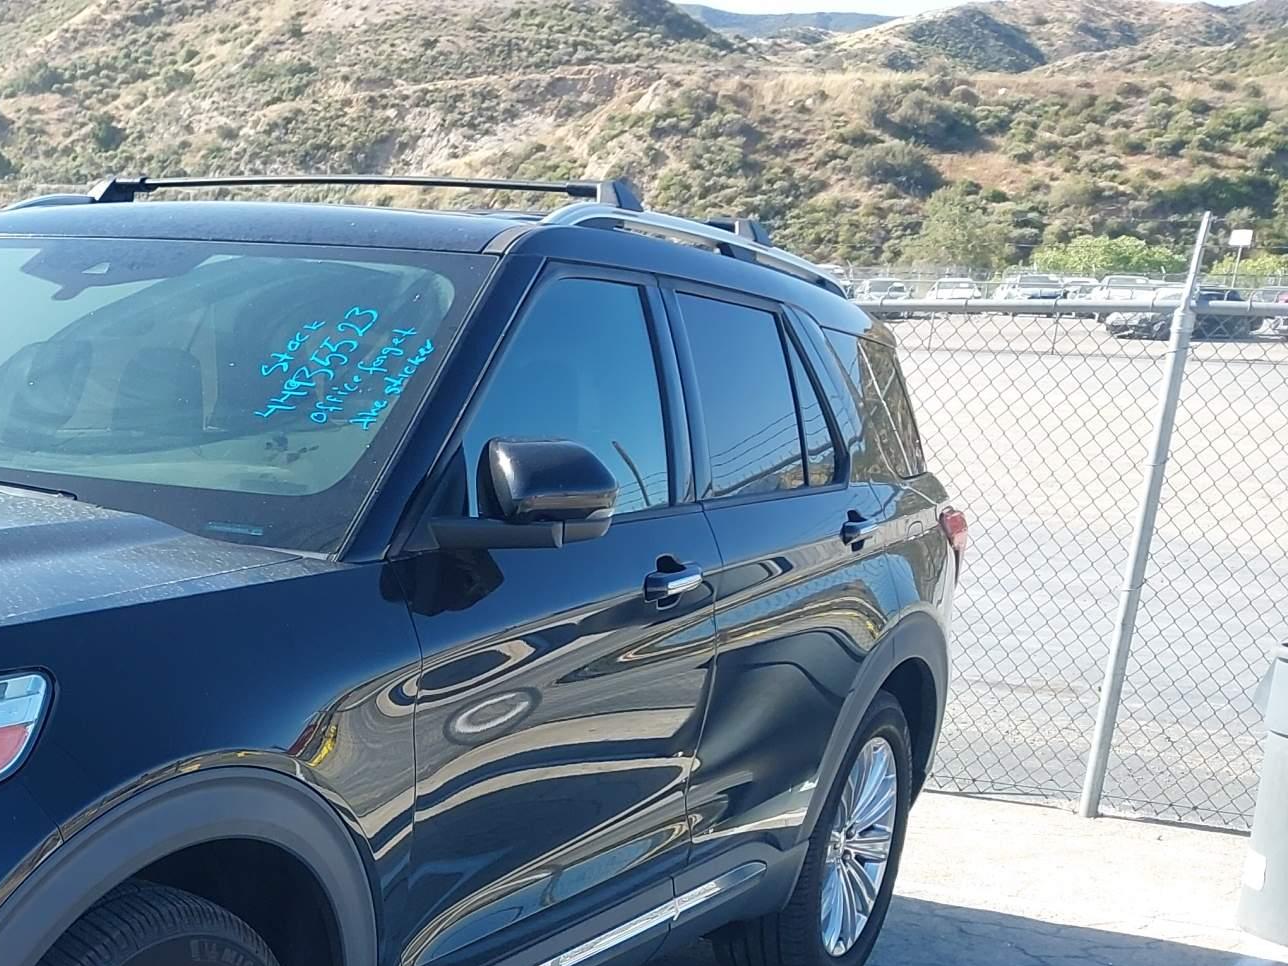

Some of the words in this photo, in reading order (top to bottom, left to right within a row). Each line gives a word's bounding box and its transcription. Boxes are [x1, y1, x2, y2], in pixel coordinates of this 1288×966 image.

[253, 306, 379, 418] 44935523
[261, 320, 326, 376] Stock
[349, 399, 388, 430] the
